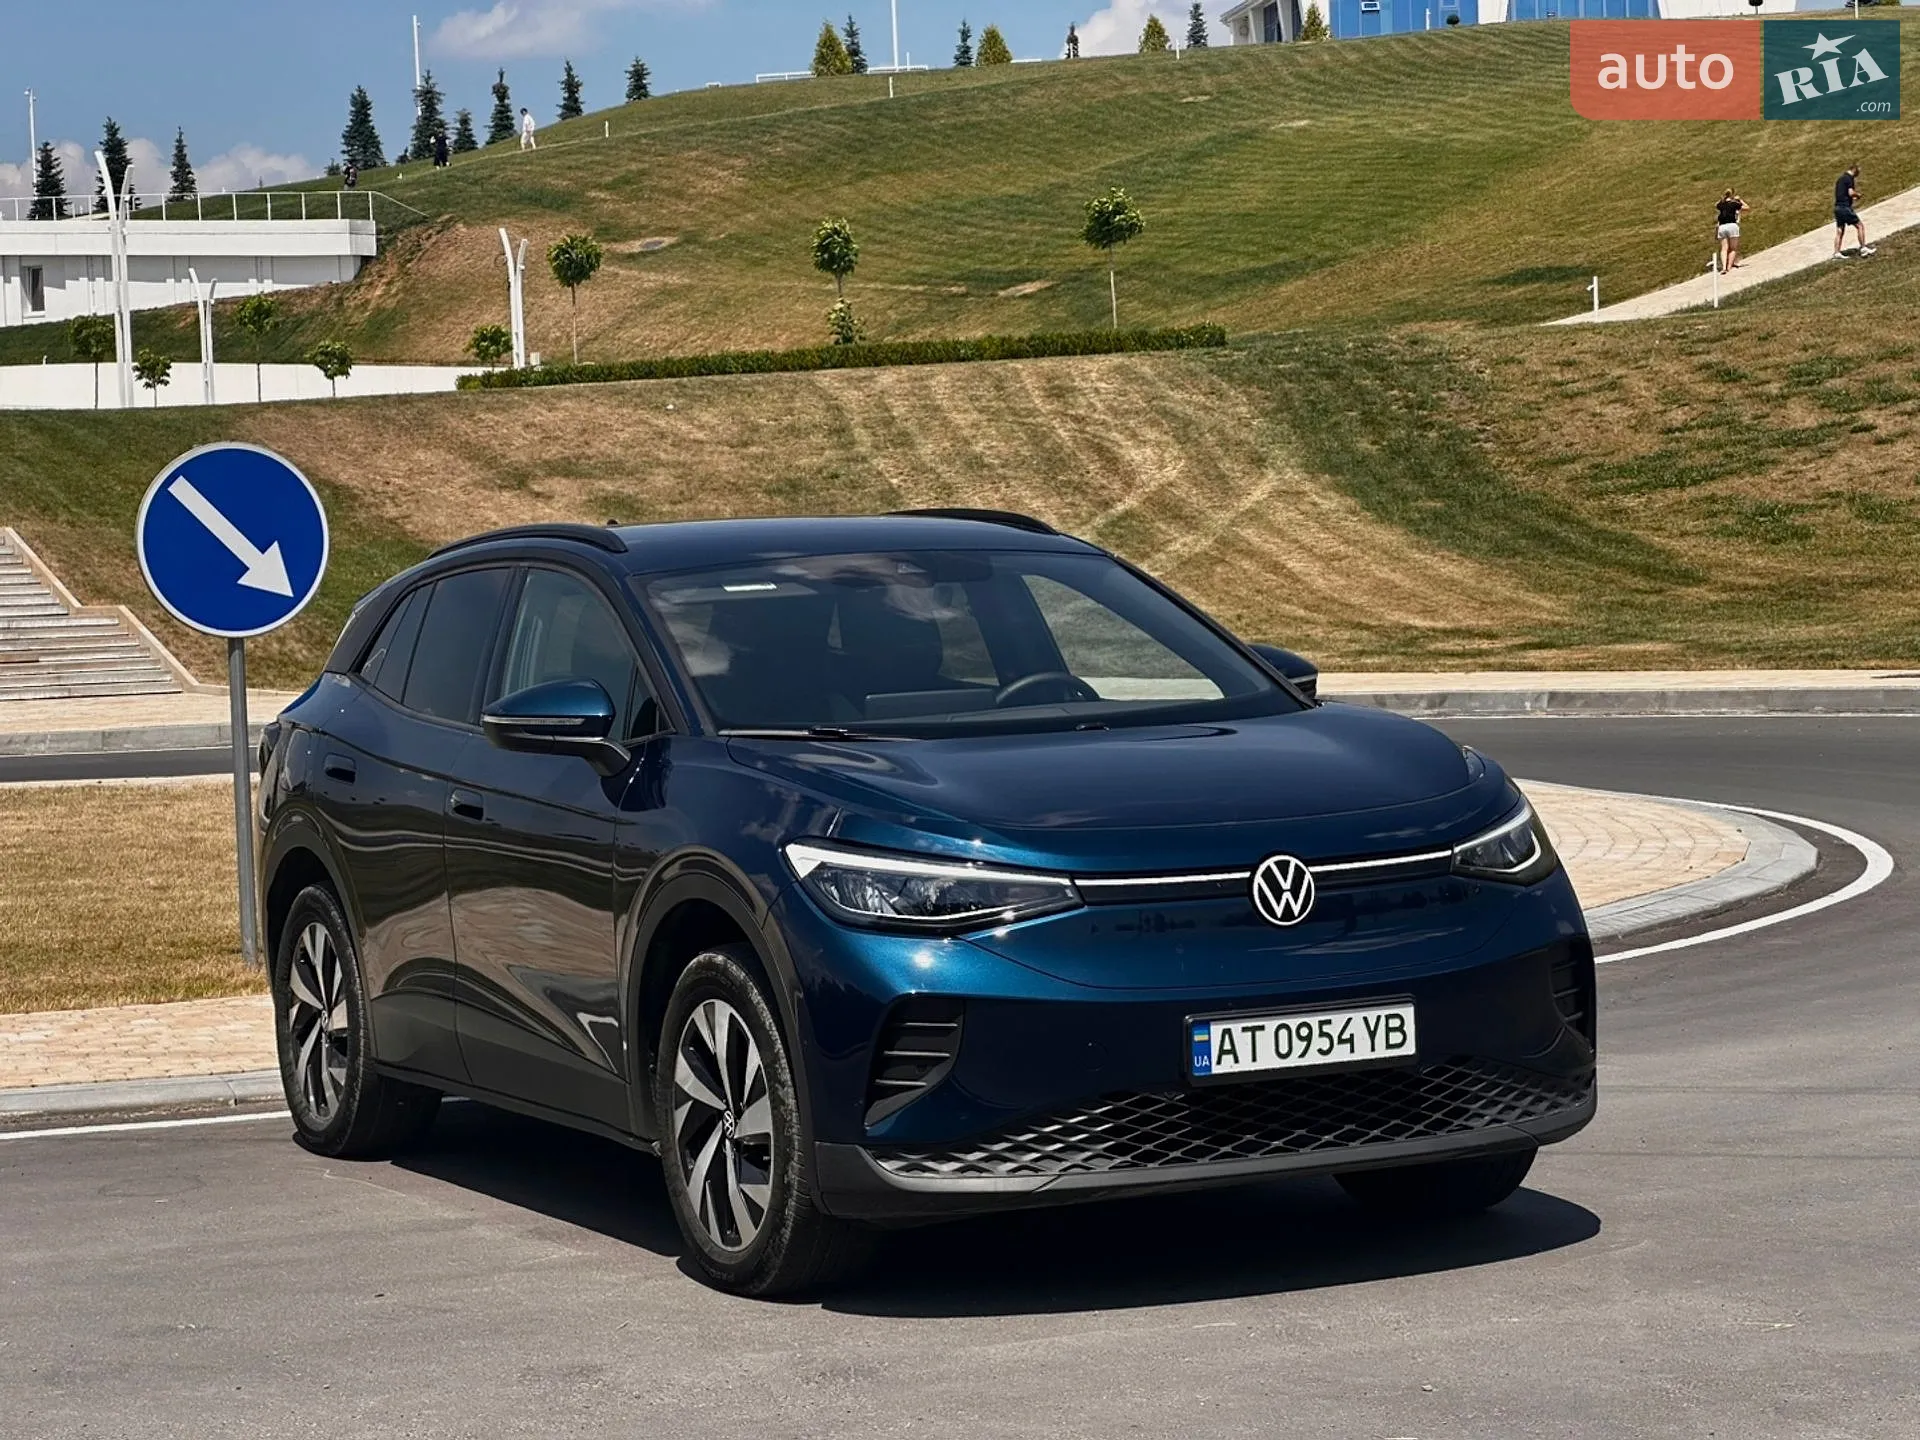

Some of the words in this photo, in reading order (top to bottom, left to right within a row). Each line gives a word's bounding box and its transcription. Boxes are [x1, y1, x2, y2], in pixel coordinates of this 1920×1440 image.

[1216, 1025, 1265, 1065] AT
[1273, 1017, 1355, 1060] 0954
[1363, 1013, 1408, 1052] YB
[1194, 1055, 1210, 1067] UA
